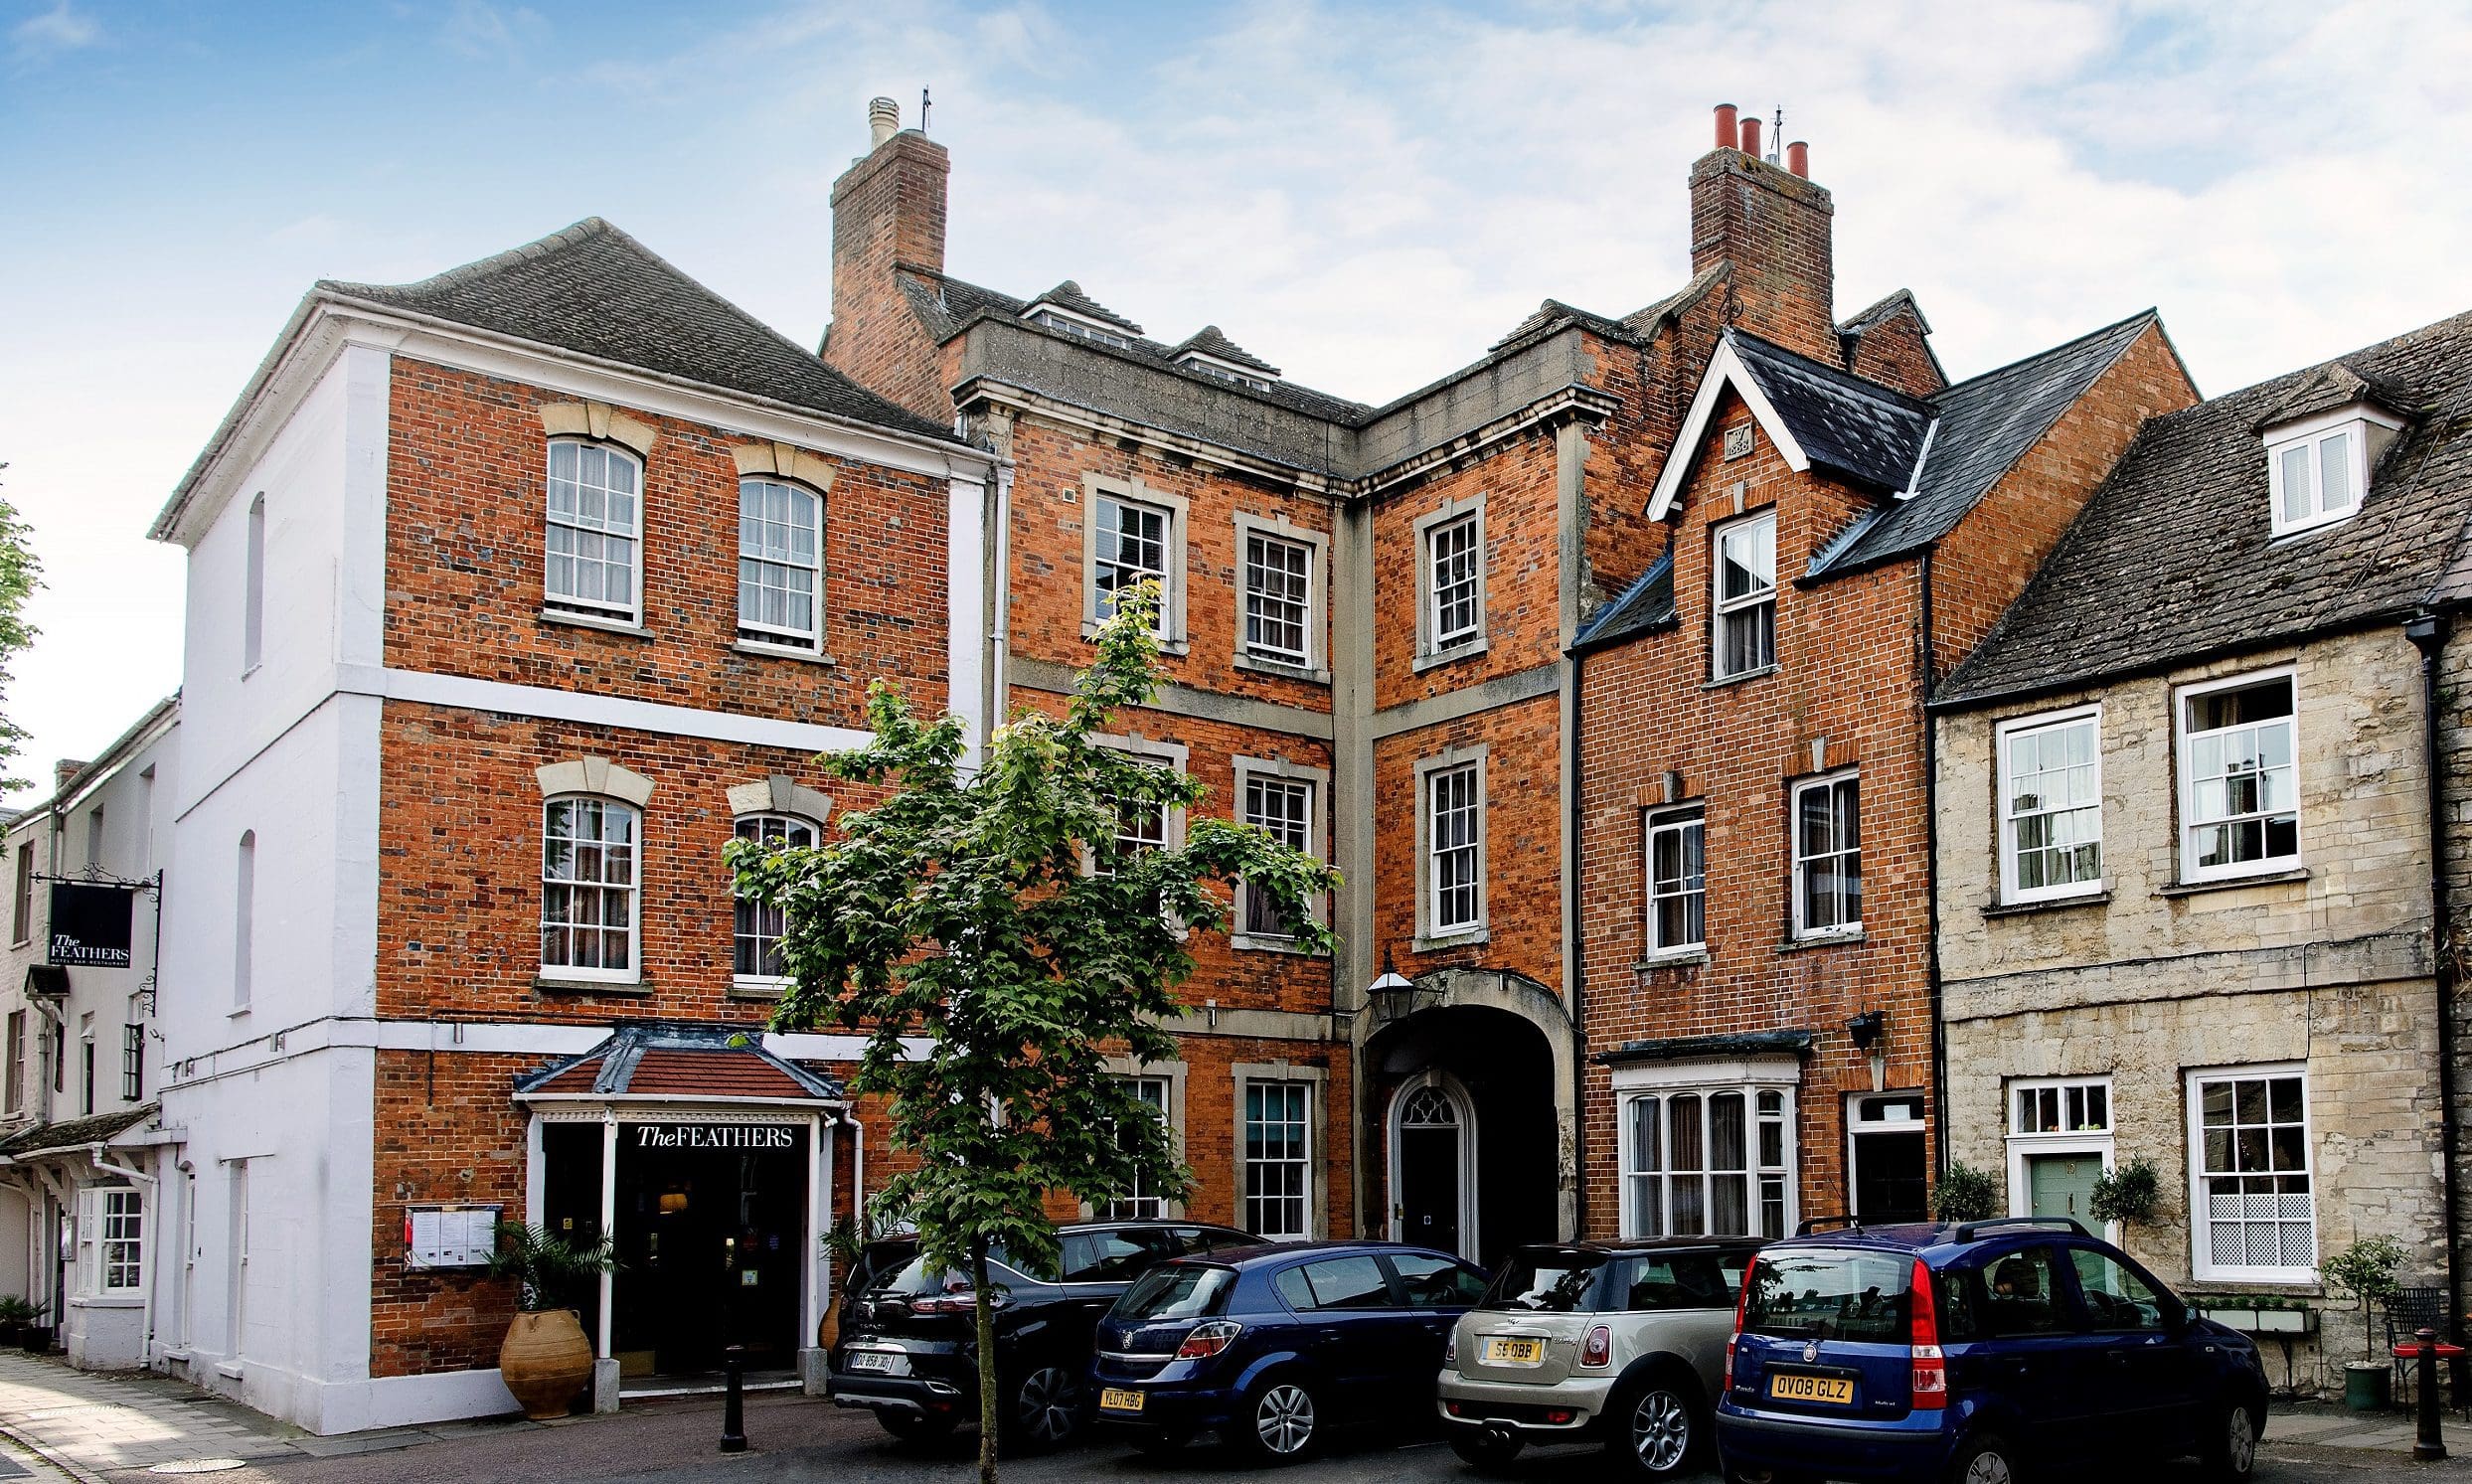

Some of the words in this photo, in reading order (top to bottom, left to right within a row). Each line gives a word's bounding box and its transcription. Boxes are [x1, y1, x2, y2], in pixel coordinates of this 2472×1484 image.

[55, 934, 80, 946] The
[51, 945, 129, 960] FEATHERS
[1777, 1377, 1814, 1396] OV08
[1817, 1380, 1847, 1399] GLZ
[1105, 1392, 1124, 1405] YL07
